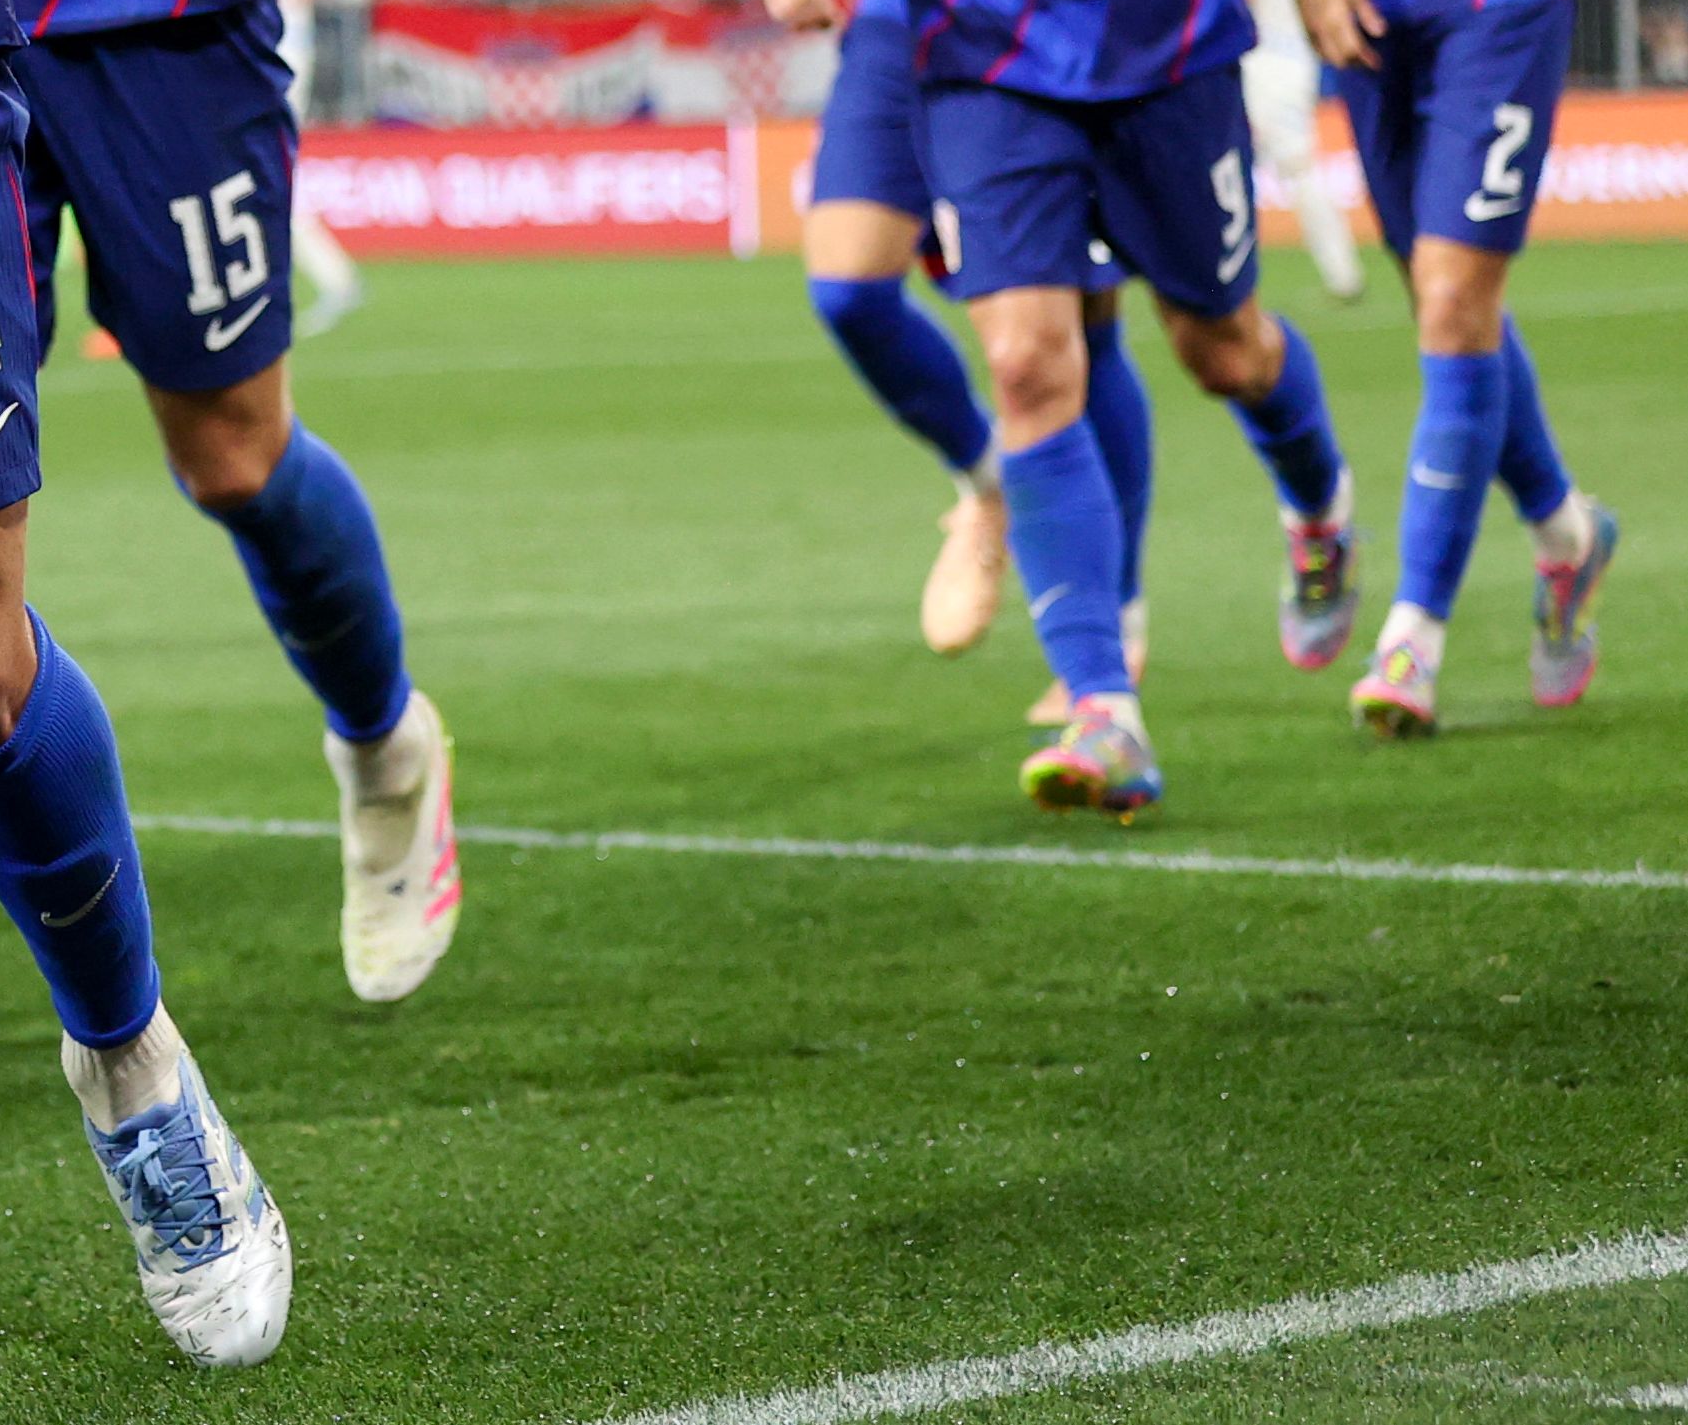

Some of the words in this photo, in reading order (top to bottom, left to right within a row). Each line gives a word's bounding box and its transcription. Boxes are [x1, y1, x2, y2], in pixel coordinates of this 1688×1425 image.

[1209, 147, 1250, 250] 9
[1481, 102, 1535, 196] 2
[168, 169, 270, 316] 15
